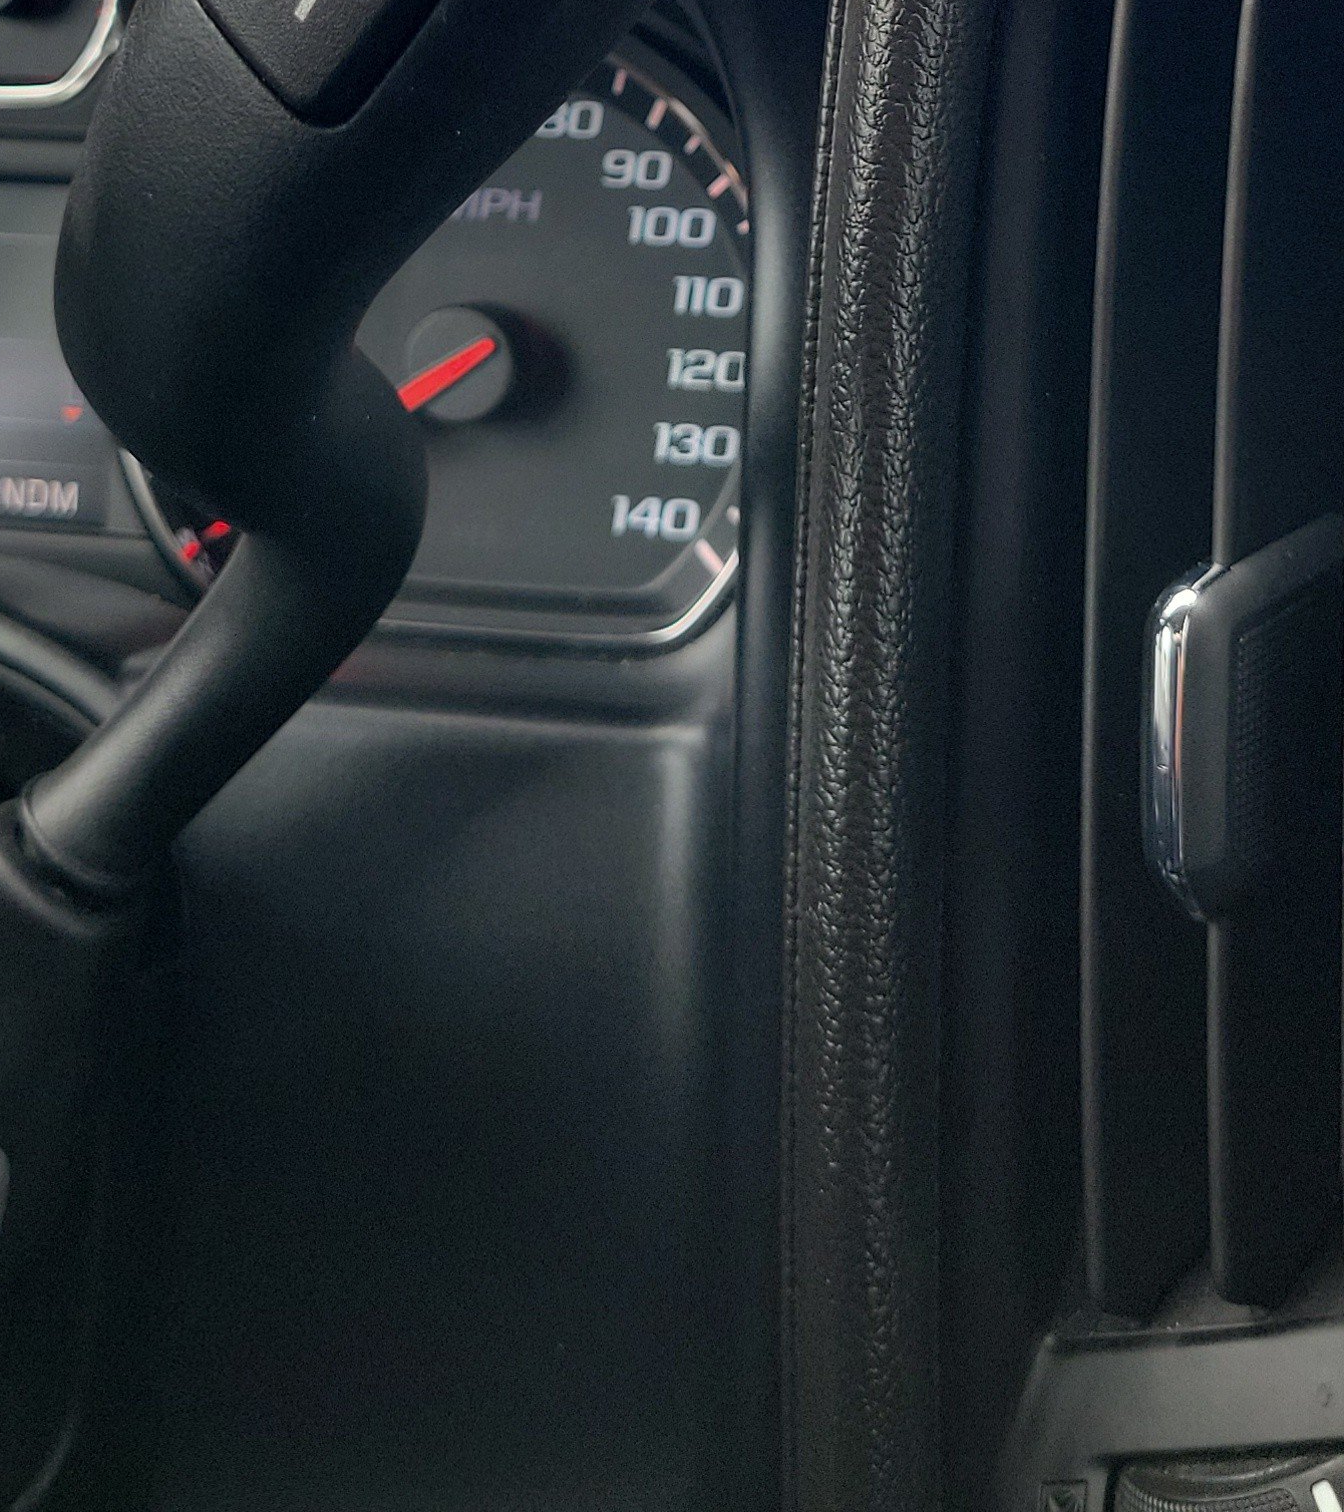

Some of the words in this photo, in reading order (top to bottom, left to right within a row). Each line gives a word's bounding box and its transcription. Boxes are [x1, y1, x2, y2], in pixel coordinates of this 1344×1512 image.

[601, 149, 673, 189] 90
[627, 206, 717, 247] 100
[673, 274, 745, 318] 110
[667, 346, 746, 390] 120
[653, 422, 741, 466] 130
[610, 494, 702, 541] 140
